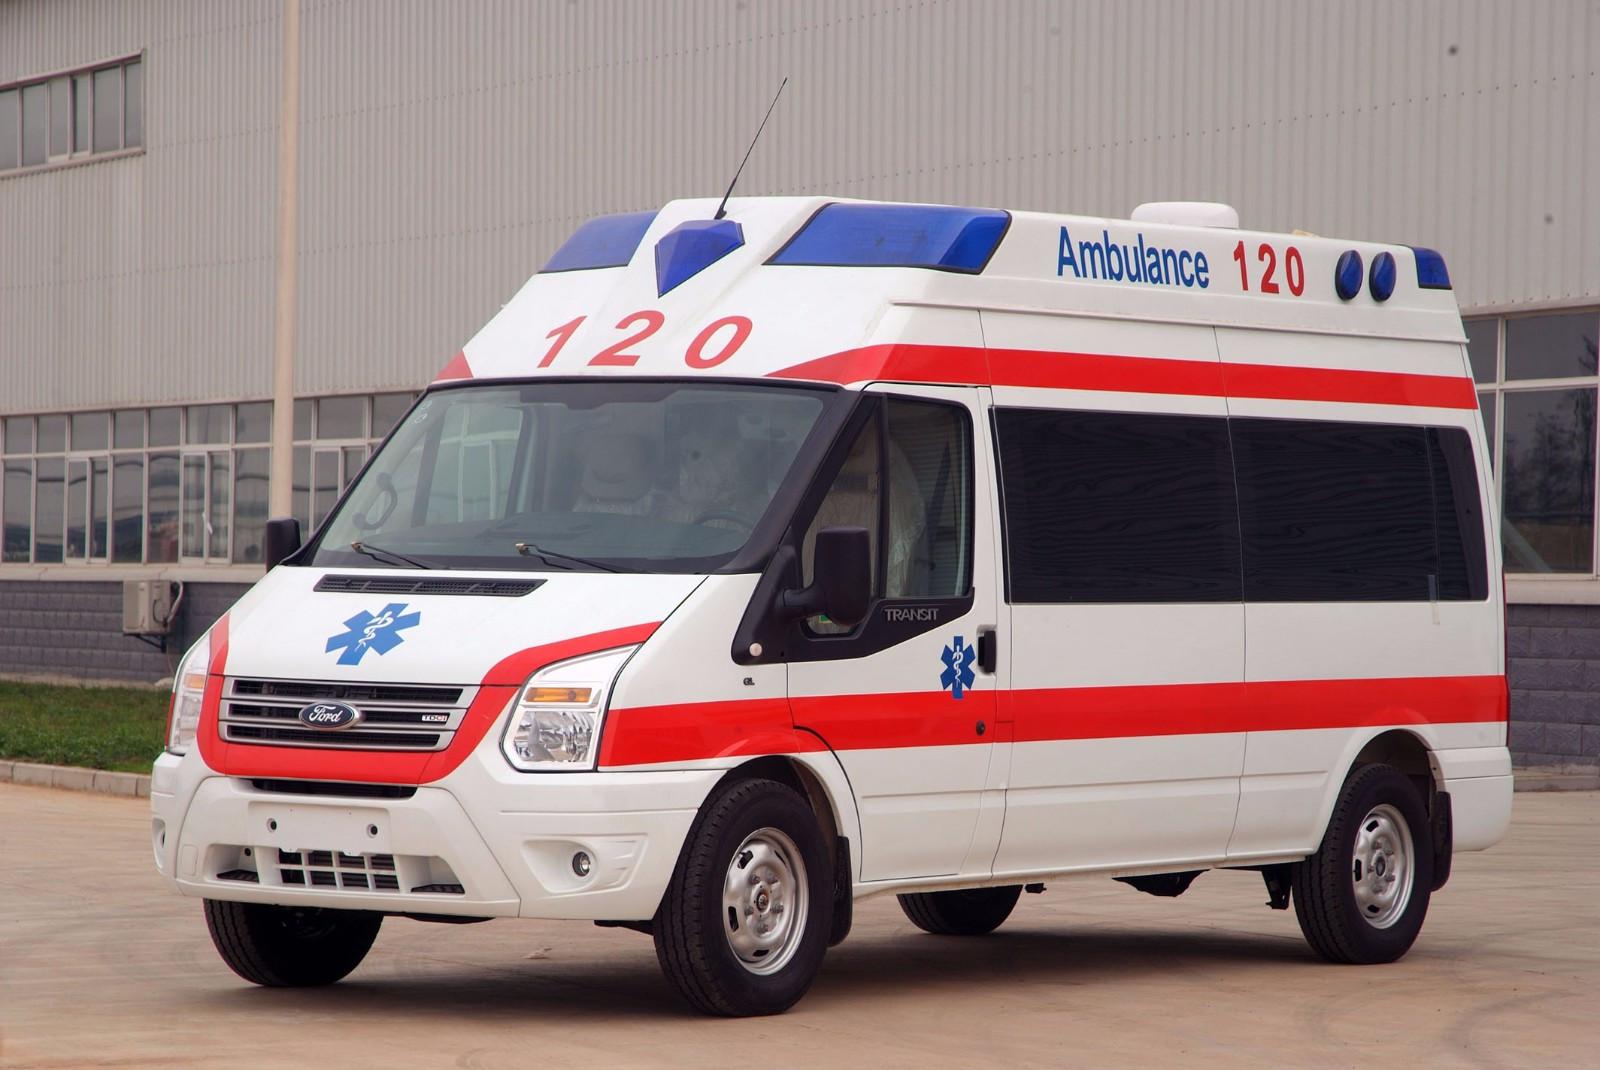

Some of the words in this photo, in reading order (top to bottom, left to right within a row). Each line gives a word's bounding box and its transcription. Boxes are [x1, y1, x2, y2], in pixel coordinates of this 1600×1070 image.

[1057, 226, 1210, 289] Ambulance
[1233, 240, 1305, 297] 120
[537, 310, 753, 369] 120
[884, 608, 939, 621] TRANSIT
[309, 704, 343, 723] Ford
